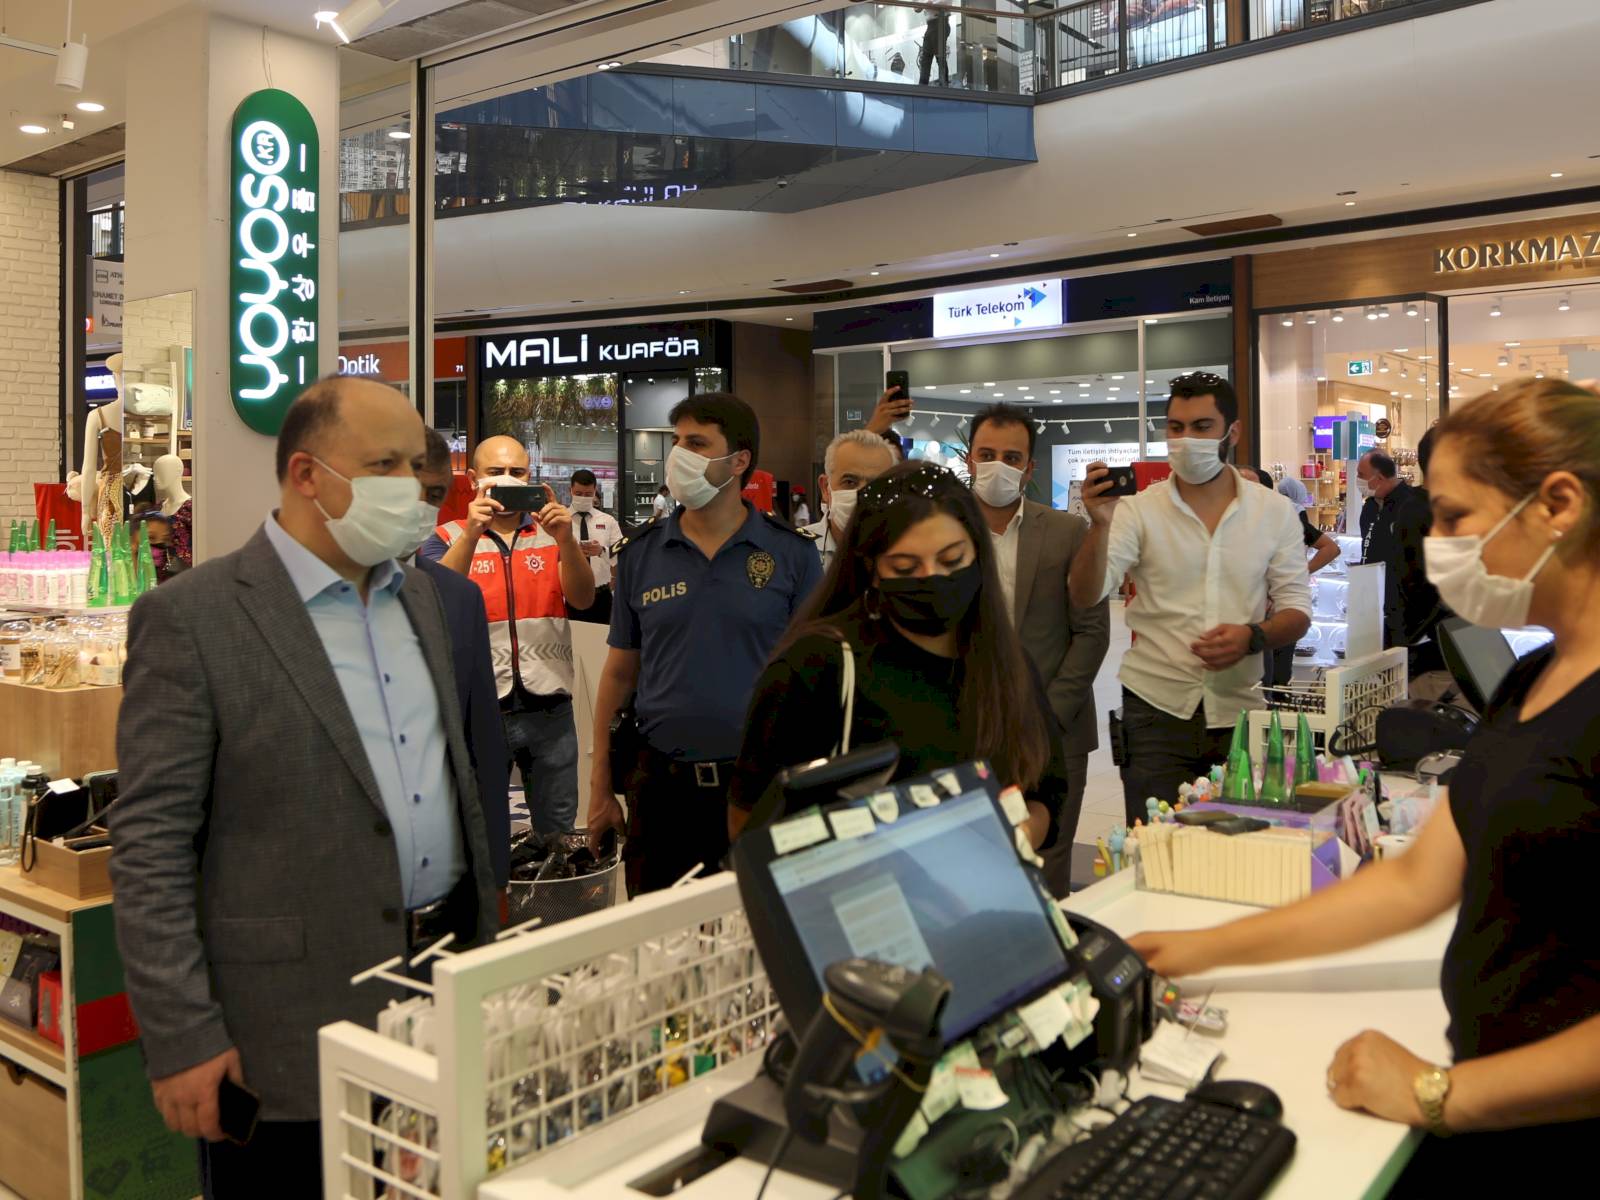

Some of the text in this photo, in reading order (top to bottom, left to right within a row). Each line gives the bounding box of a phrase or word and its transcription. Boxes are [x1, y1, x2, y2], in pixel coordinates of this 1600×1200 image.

[1433, 231, 1600, 273] KORKMAZ
[948, 301, 1025, 319] Türk Telekom
[599, 337, 700, 361] KUAFÖR
[455, 365, 464, 373] 71
[1067, 448, 1082, 456] Tüm
